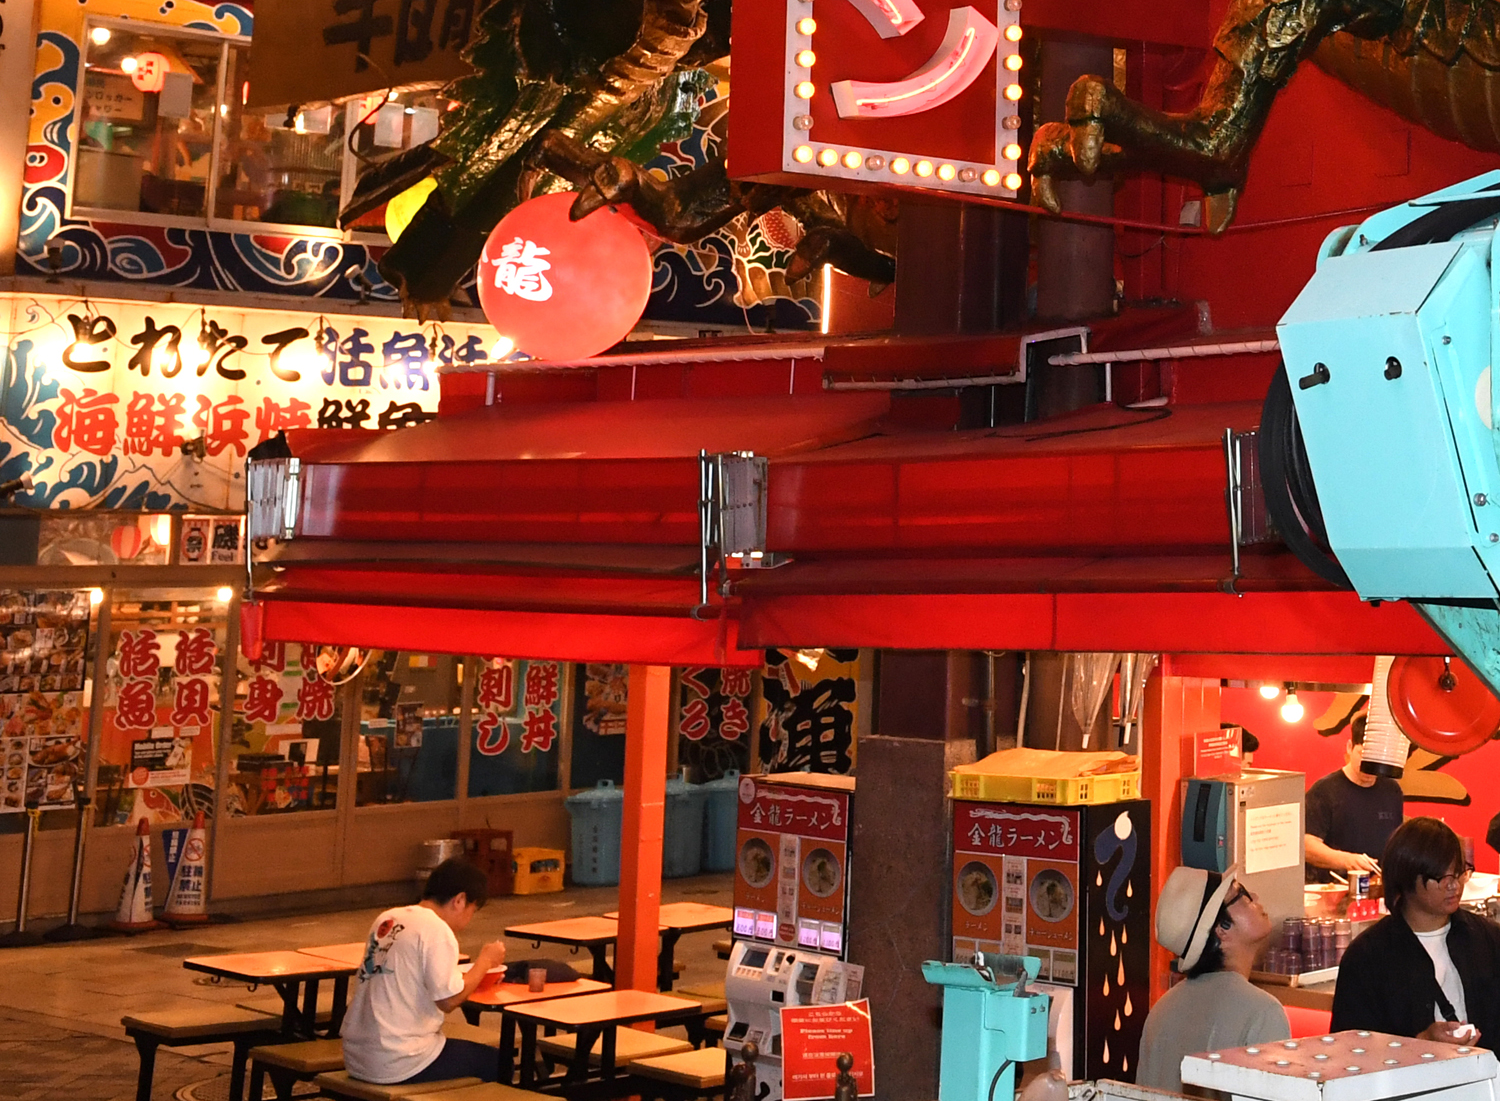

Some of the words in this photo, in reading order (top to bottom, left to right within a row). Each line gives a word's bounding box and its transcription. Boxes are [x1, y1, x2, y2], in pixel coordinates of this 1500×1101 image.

[491, 237, 553, 302] 龍
[477, 657, 513, 755] 刺し
[750, 803, 831, 830] 金龍ラーメン
[968, 823, 1060, 849] 金龍ラーメン
